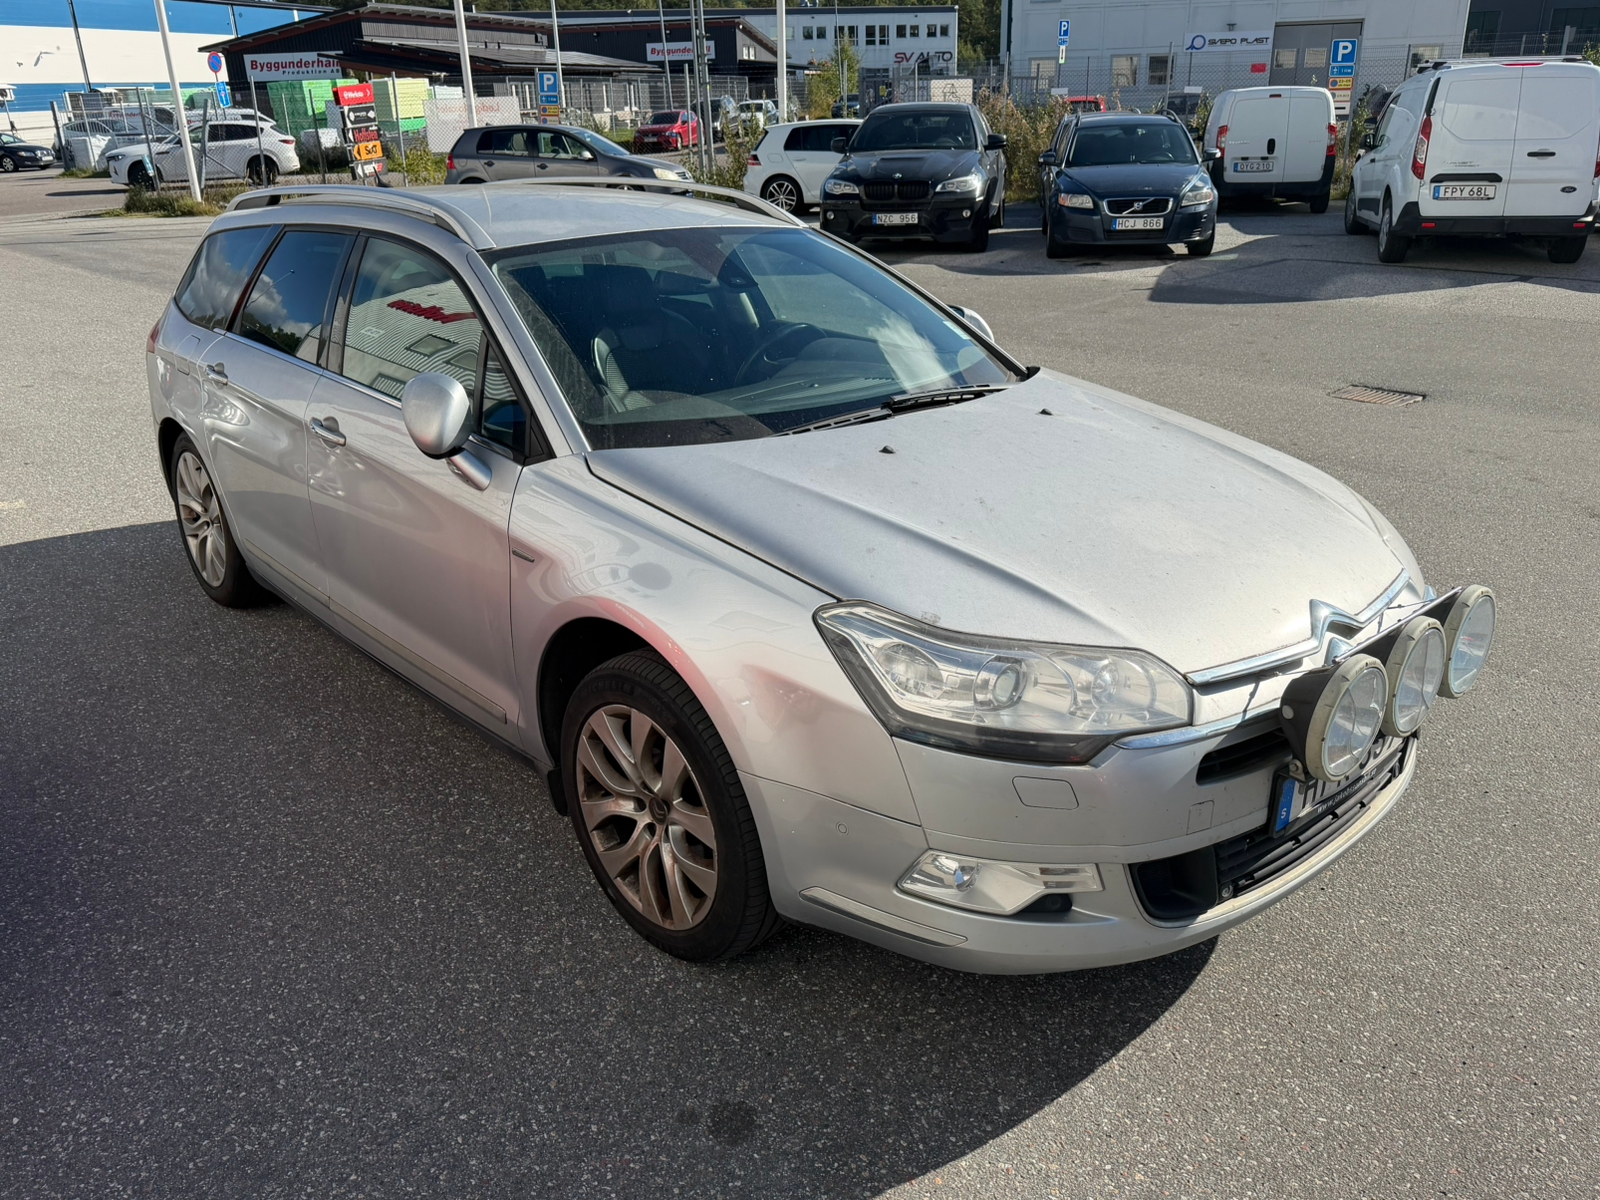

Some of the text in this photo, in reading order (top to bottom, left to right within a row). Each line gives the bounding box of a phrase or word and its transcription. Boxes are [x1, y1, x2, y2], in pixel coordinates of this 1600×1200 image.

[1061, 21, 1067, 35] P
[1337, 42, 1352, 61] P
[894, 52, 914, 63] SV
[543, 74, 554, 91] P
[1443, 187, 1489, 196] FPY 68L
[899, 214, 916, 222] 956
[1117, 219, 1161, 228] HCJ 866
[1280, 807, 1287, 819] S
